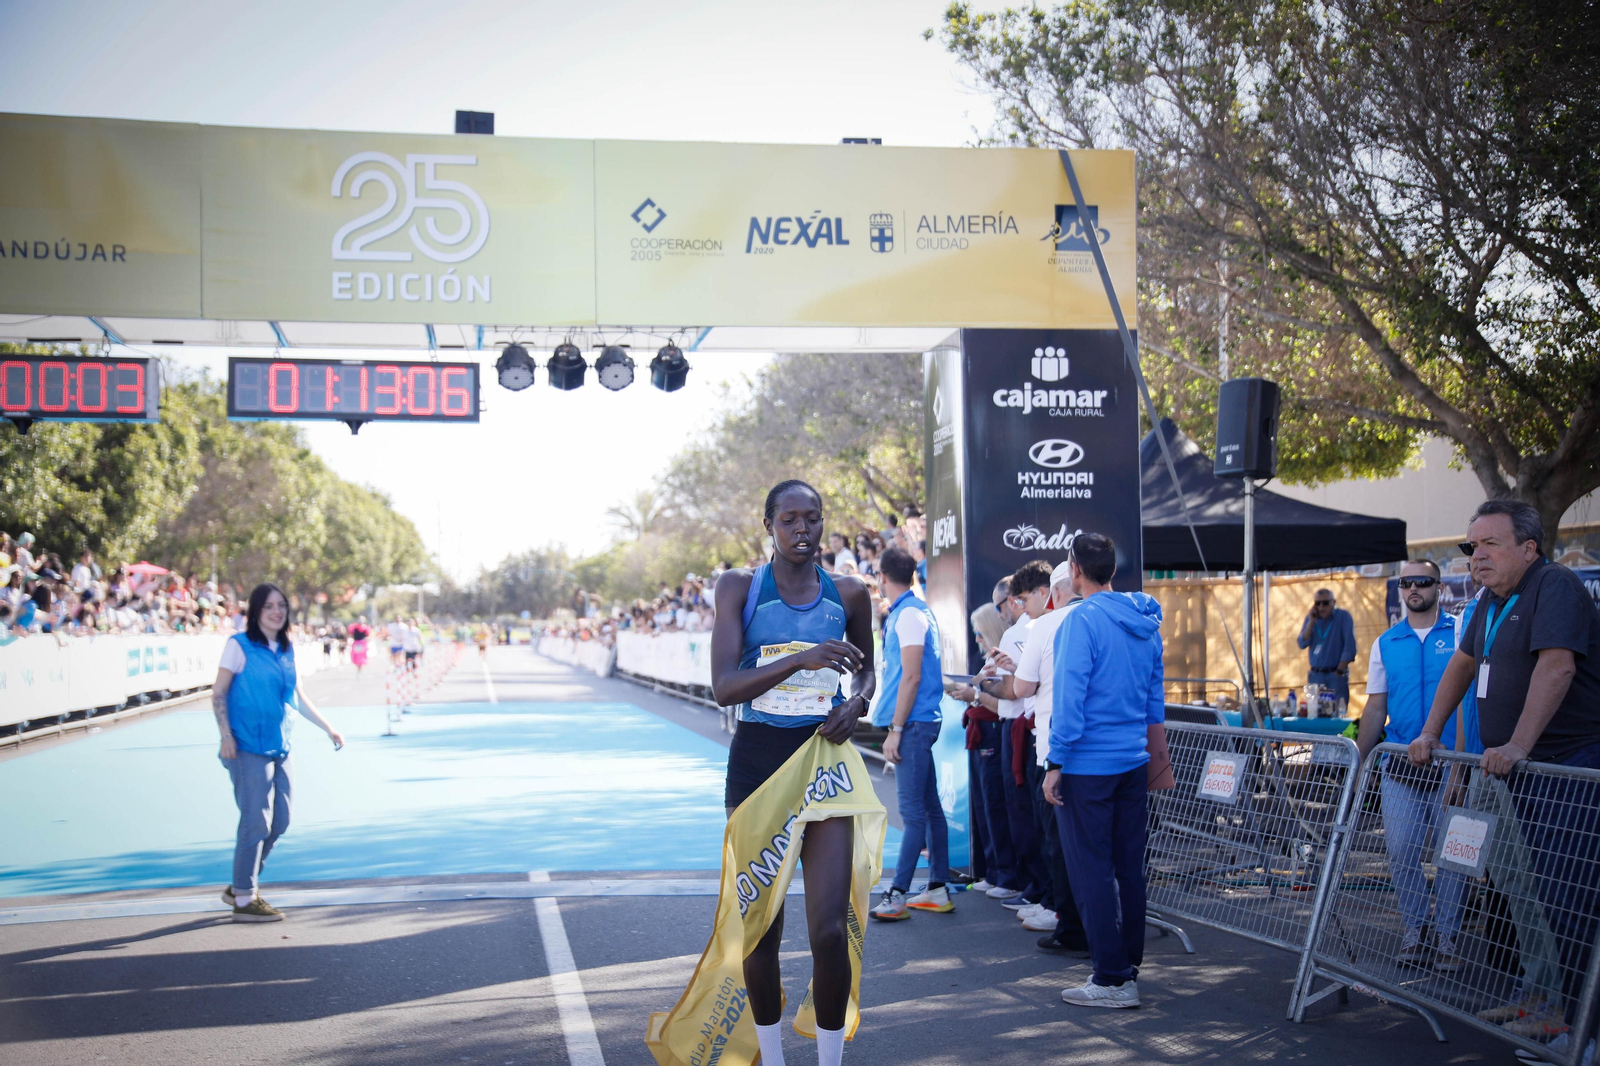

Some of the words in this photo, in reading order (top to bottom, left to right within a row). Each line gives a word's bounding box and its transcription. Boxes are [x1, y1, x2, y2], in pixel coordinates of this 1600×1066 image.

[331, 150, 491, 265] 25
[916, 210, 1020, 235] ALMERÍA
[630, 237, 723, 251] COOPERACIÓN
[915, 237, 970, 250] CIUDAD
[630, 249, 662, 261] 2005
[331, 267, 492, 303] EDICIÓN
[268, 362, 470, 417] 01:13:06
[992, 382, 1108, 415] cajamar
[1048, 408, 1073, 417] CAJA
[1074, 408, 1105, 418] RURAL
[1017, 472, 1094, 486] HYUNDAI
[1020, 486, 1092, 499] Almerialva
[1204, 778, 1234, 793] EVENTOS
[1444, 840, 1479, 861] EVENTOS
[700, 976, 735, 1040] Maratón
[719, 986, 749, 1036] 2024
